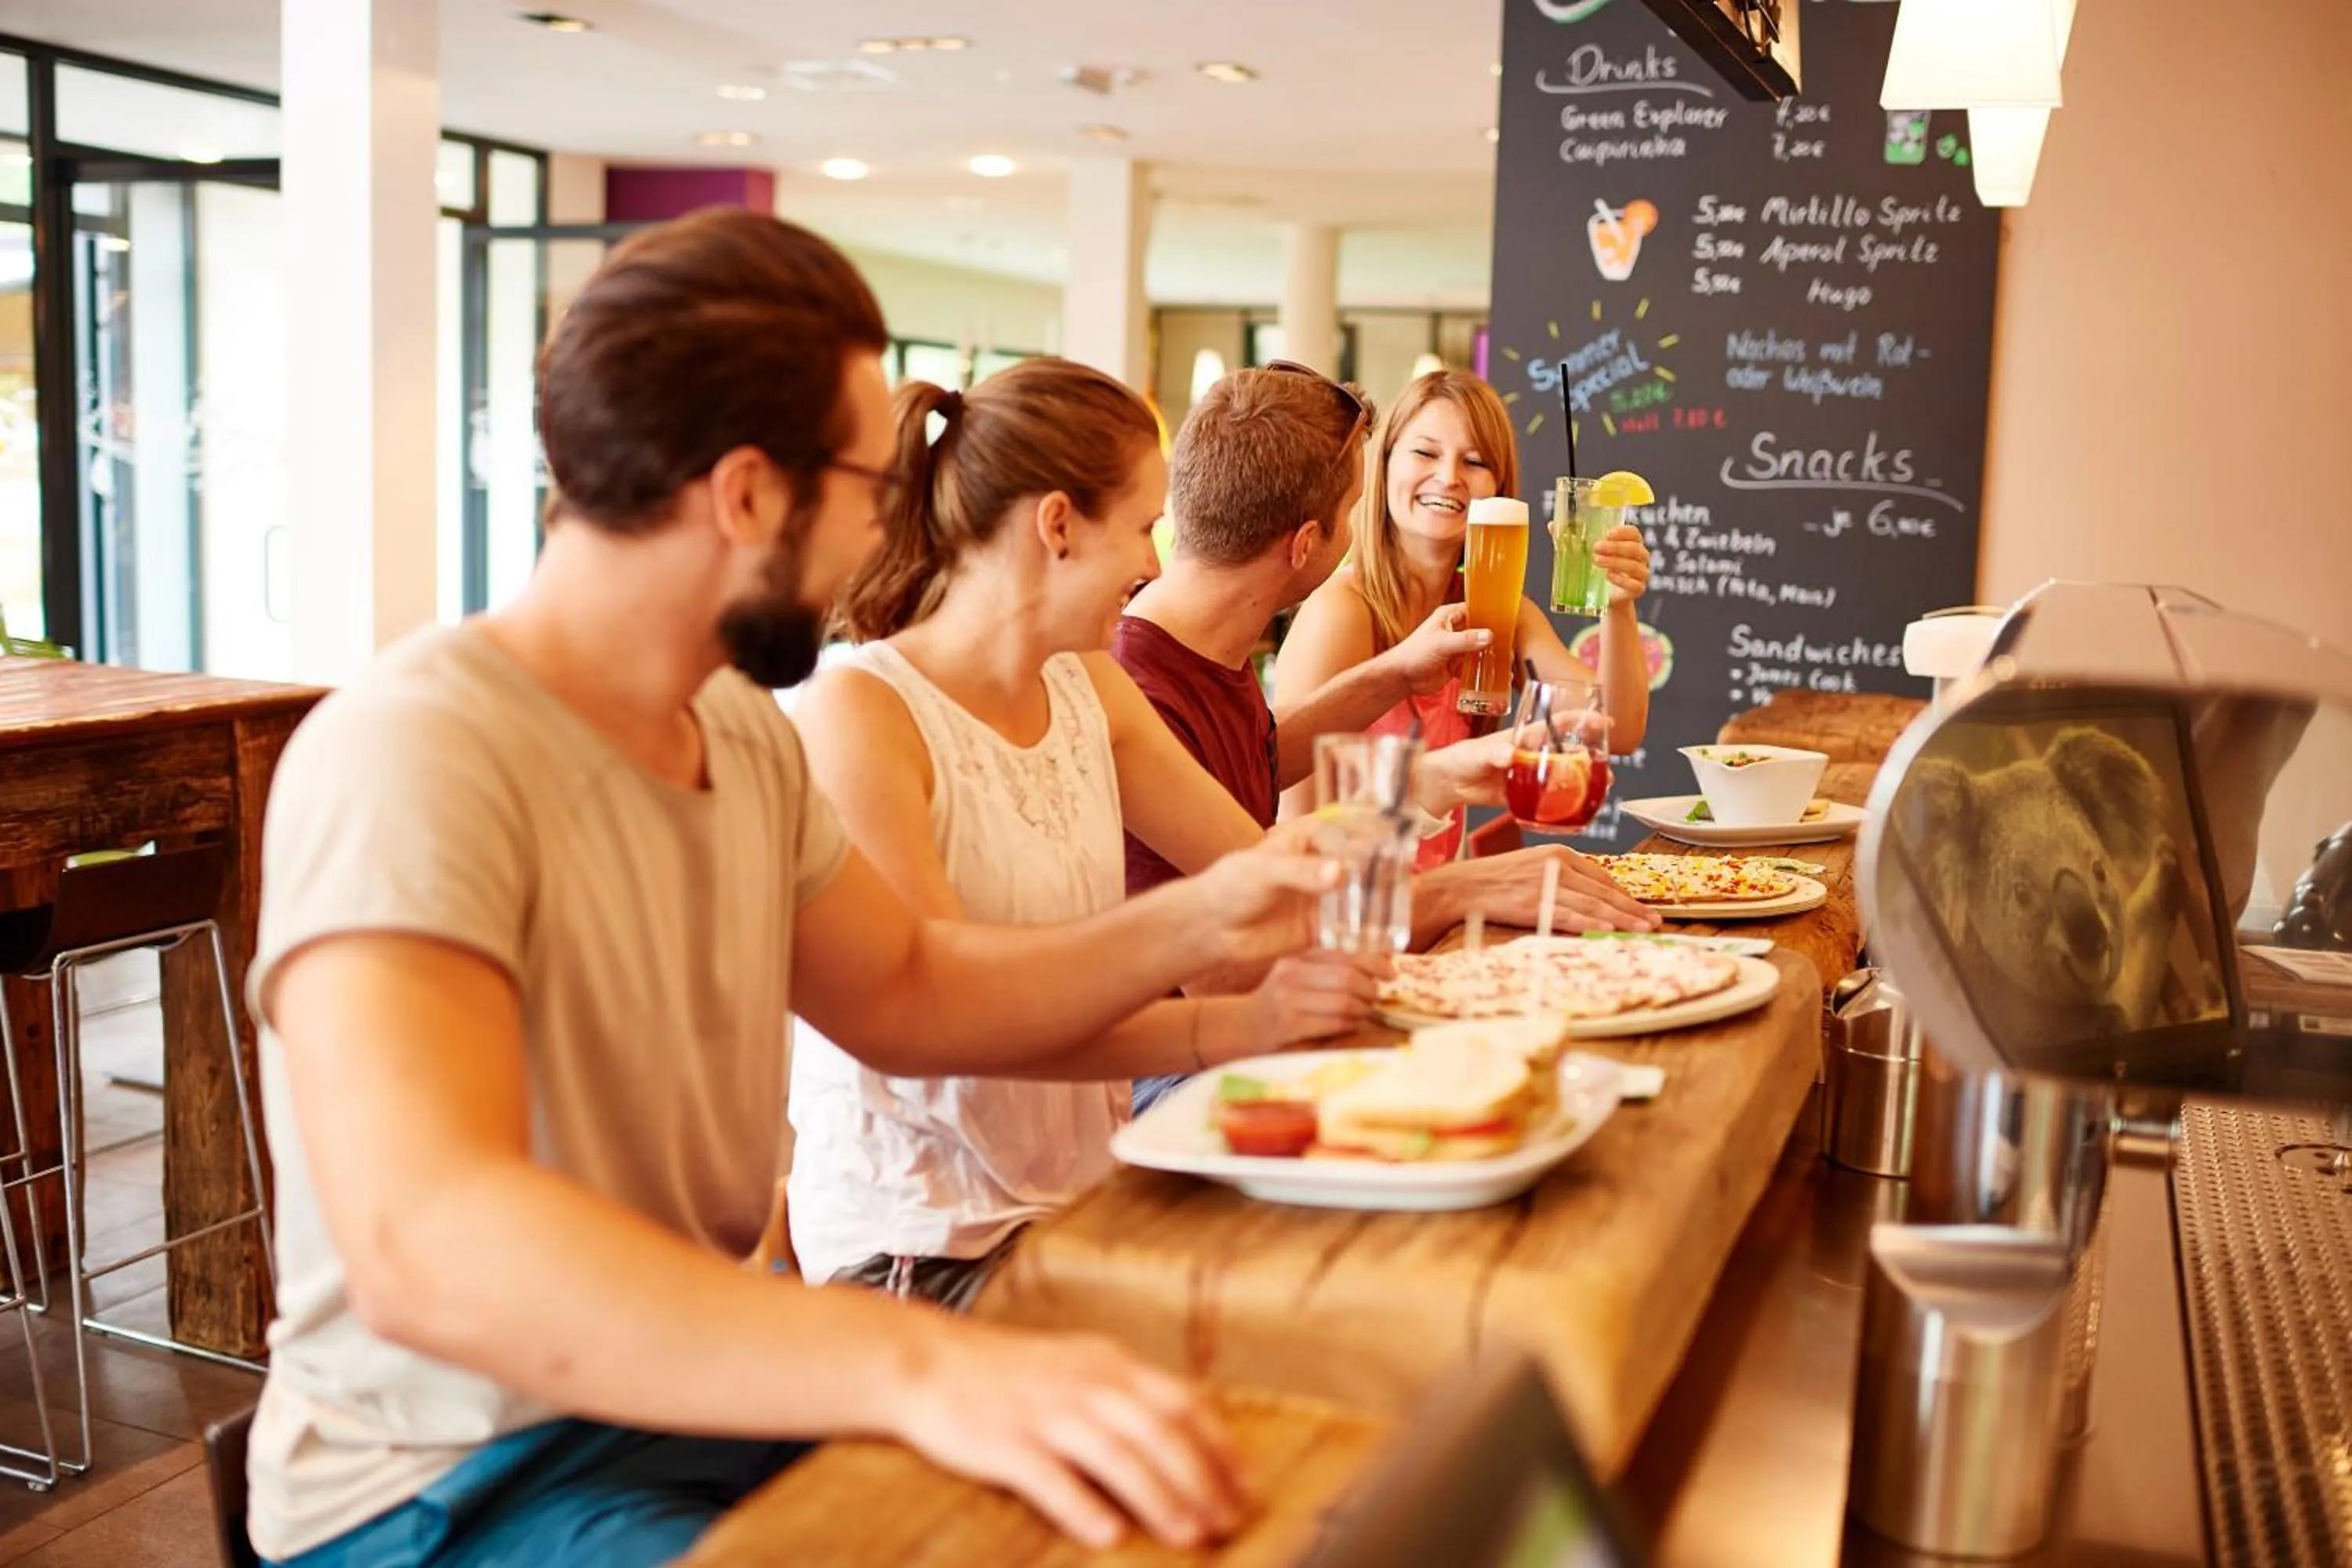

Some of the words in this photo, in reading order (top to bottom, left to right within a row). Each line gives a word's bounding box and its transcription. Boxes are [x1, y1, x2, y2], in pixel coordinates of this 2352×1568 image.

[1568, 43, 1679, 86] Drinks
[1560, 103, 1625, 130] Green
[1633, 99, 1729, 133] Explorer
[1877, 194, 1962, 236] Spritz
[1759, 235, 1847, 273] Aperol
[1856, 233, 1940, 273] Spritz
[1806, 277, 1873, 311] Hugo
[1726, 328, 1806, 363] Nachos
[1819, 329, 1858, 366] mit
[1745, 431, 1916, 484] Snacks
[1675, 549, 1745, 576] Salami
[1726, 623, 1903, 666] Sandwiches
[1809, 667, 1859, 694] Cook
